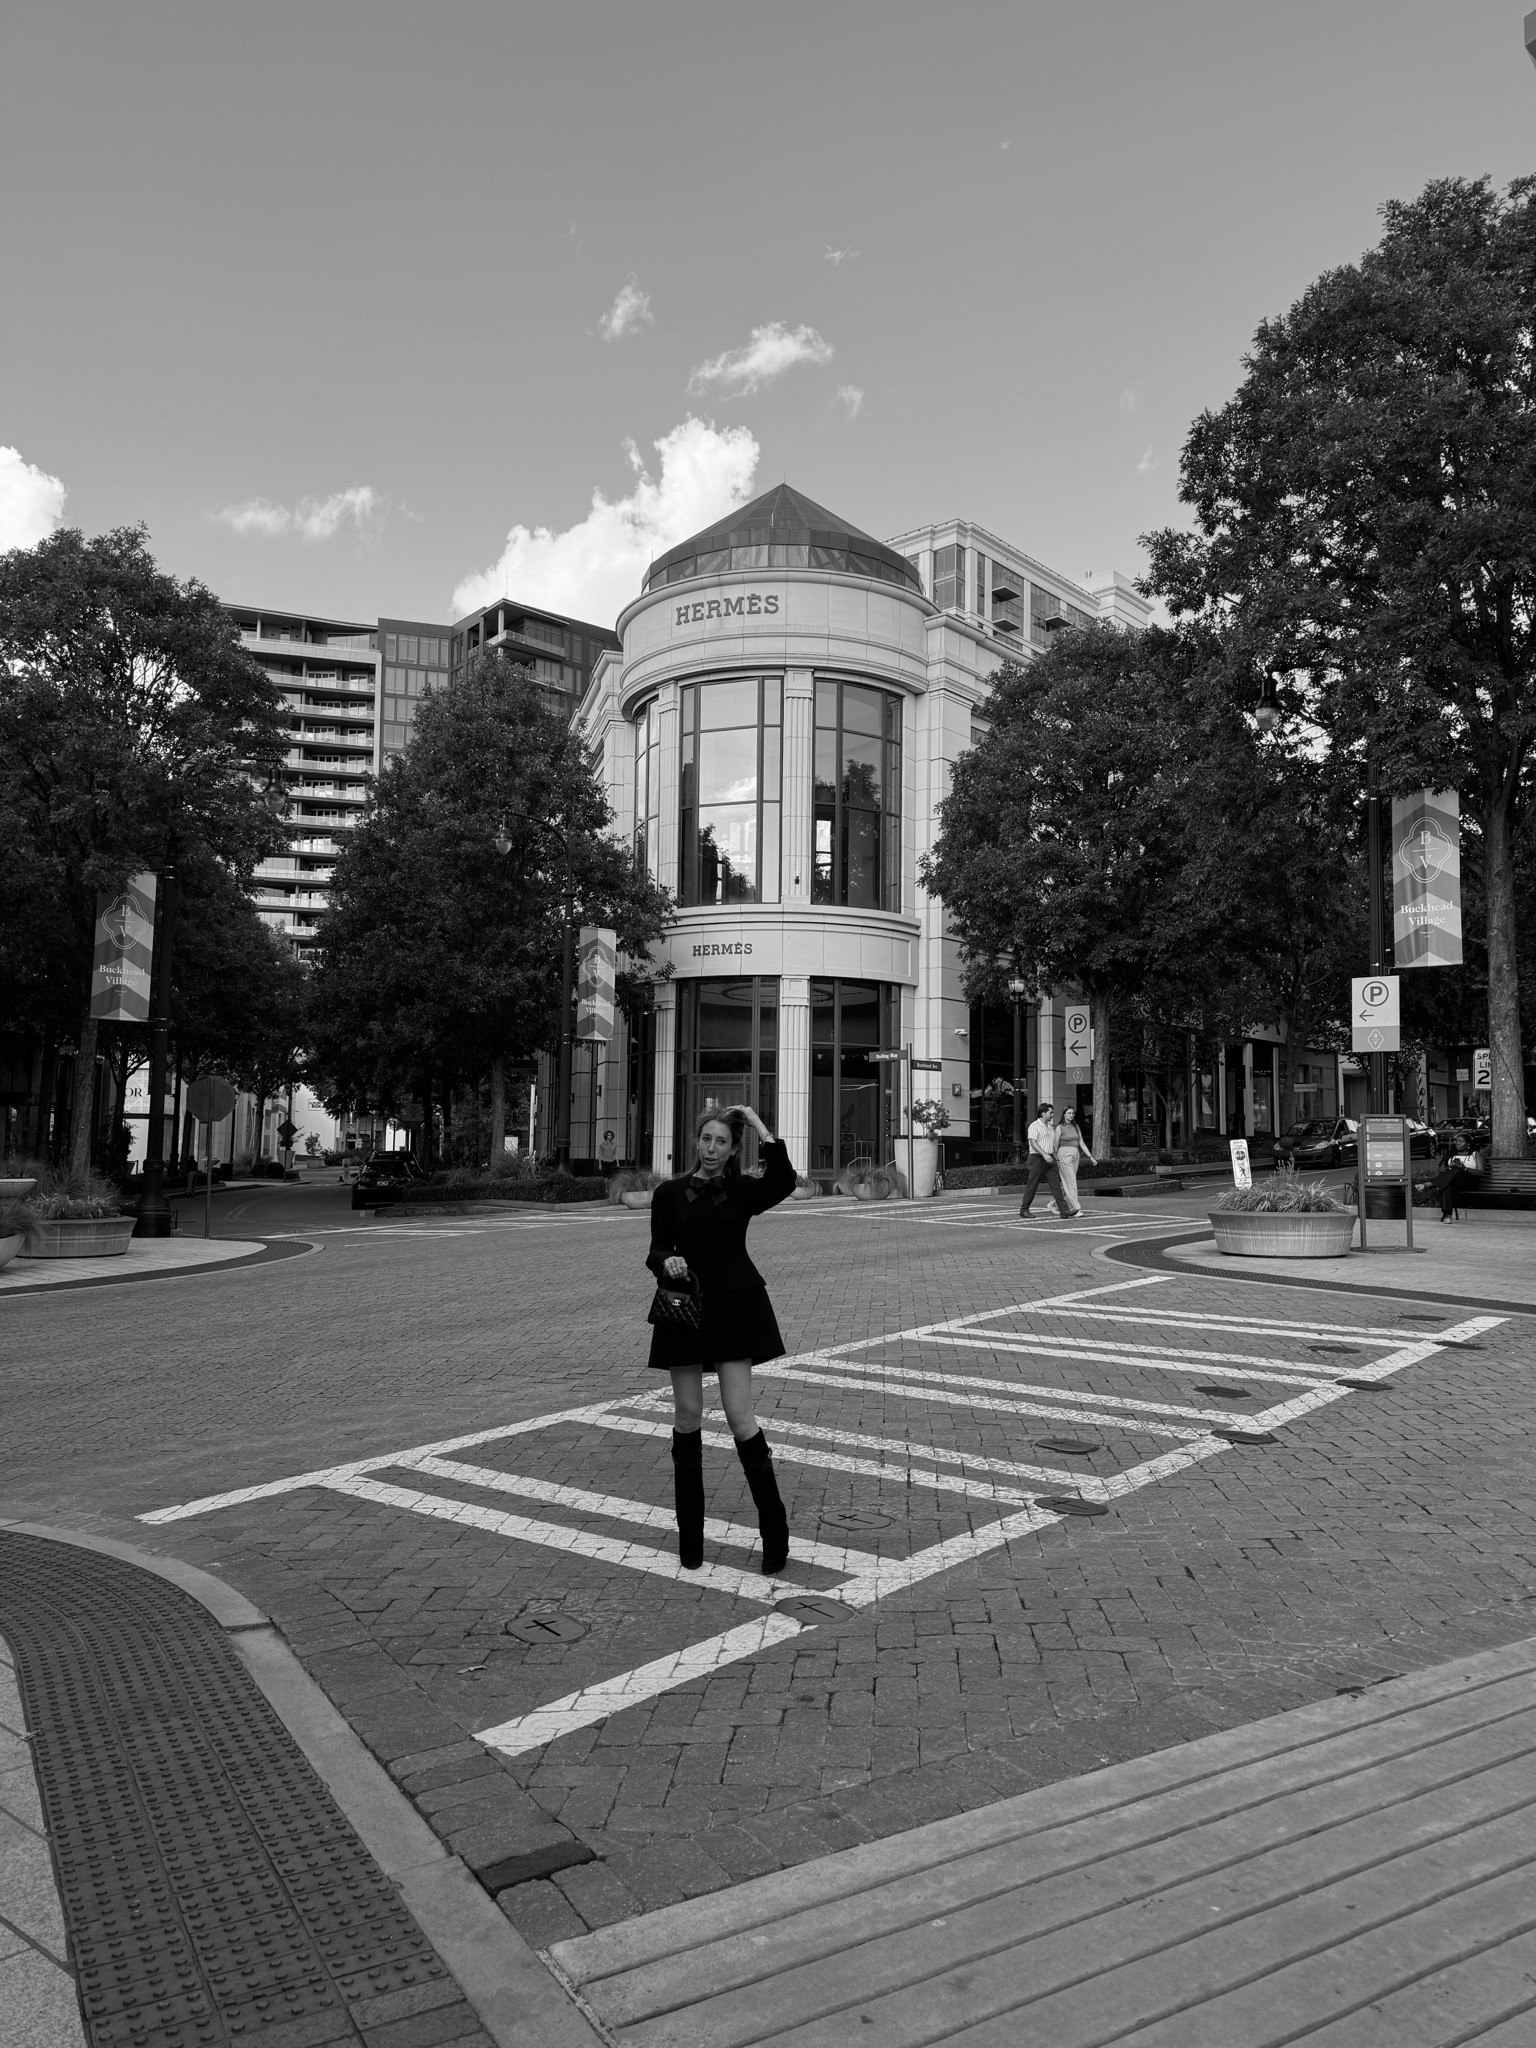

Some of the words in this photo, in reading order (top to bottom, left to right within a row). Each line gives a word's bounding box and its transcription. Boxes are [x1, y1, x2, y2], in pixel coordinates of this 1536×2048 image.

[675, 593, 779, 626] HERMÈS
[1420, 830, 1432, 845] B
[1419, 855, 1433, 869] V
[121, 904, 131, 917] B
[1400, 900, 1454, 914] Buckhead
[1408, 915, 1446, 927] Village
[119, 925, 131, 938] V
[692, 941, 753, 957] HERMÈS
[98, 964, 145, 976] Buckhead
[105, 976, 139, 988] Village
[1370, 986, 1383, 1002] P
[1073, 1017, 1083, 1030] P
